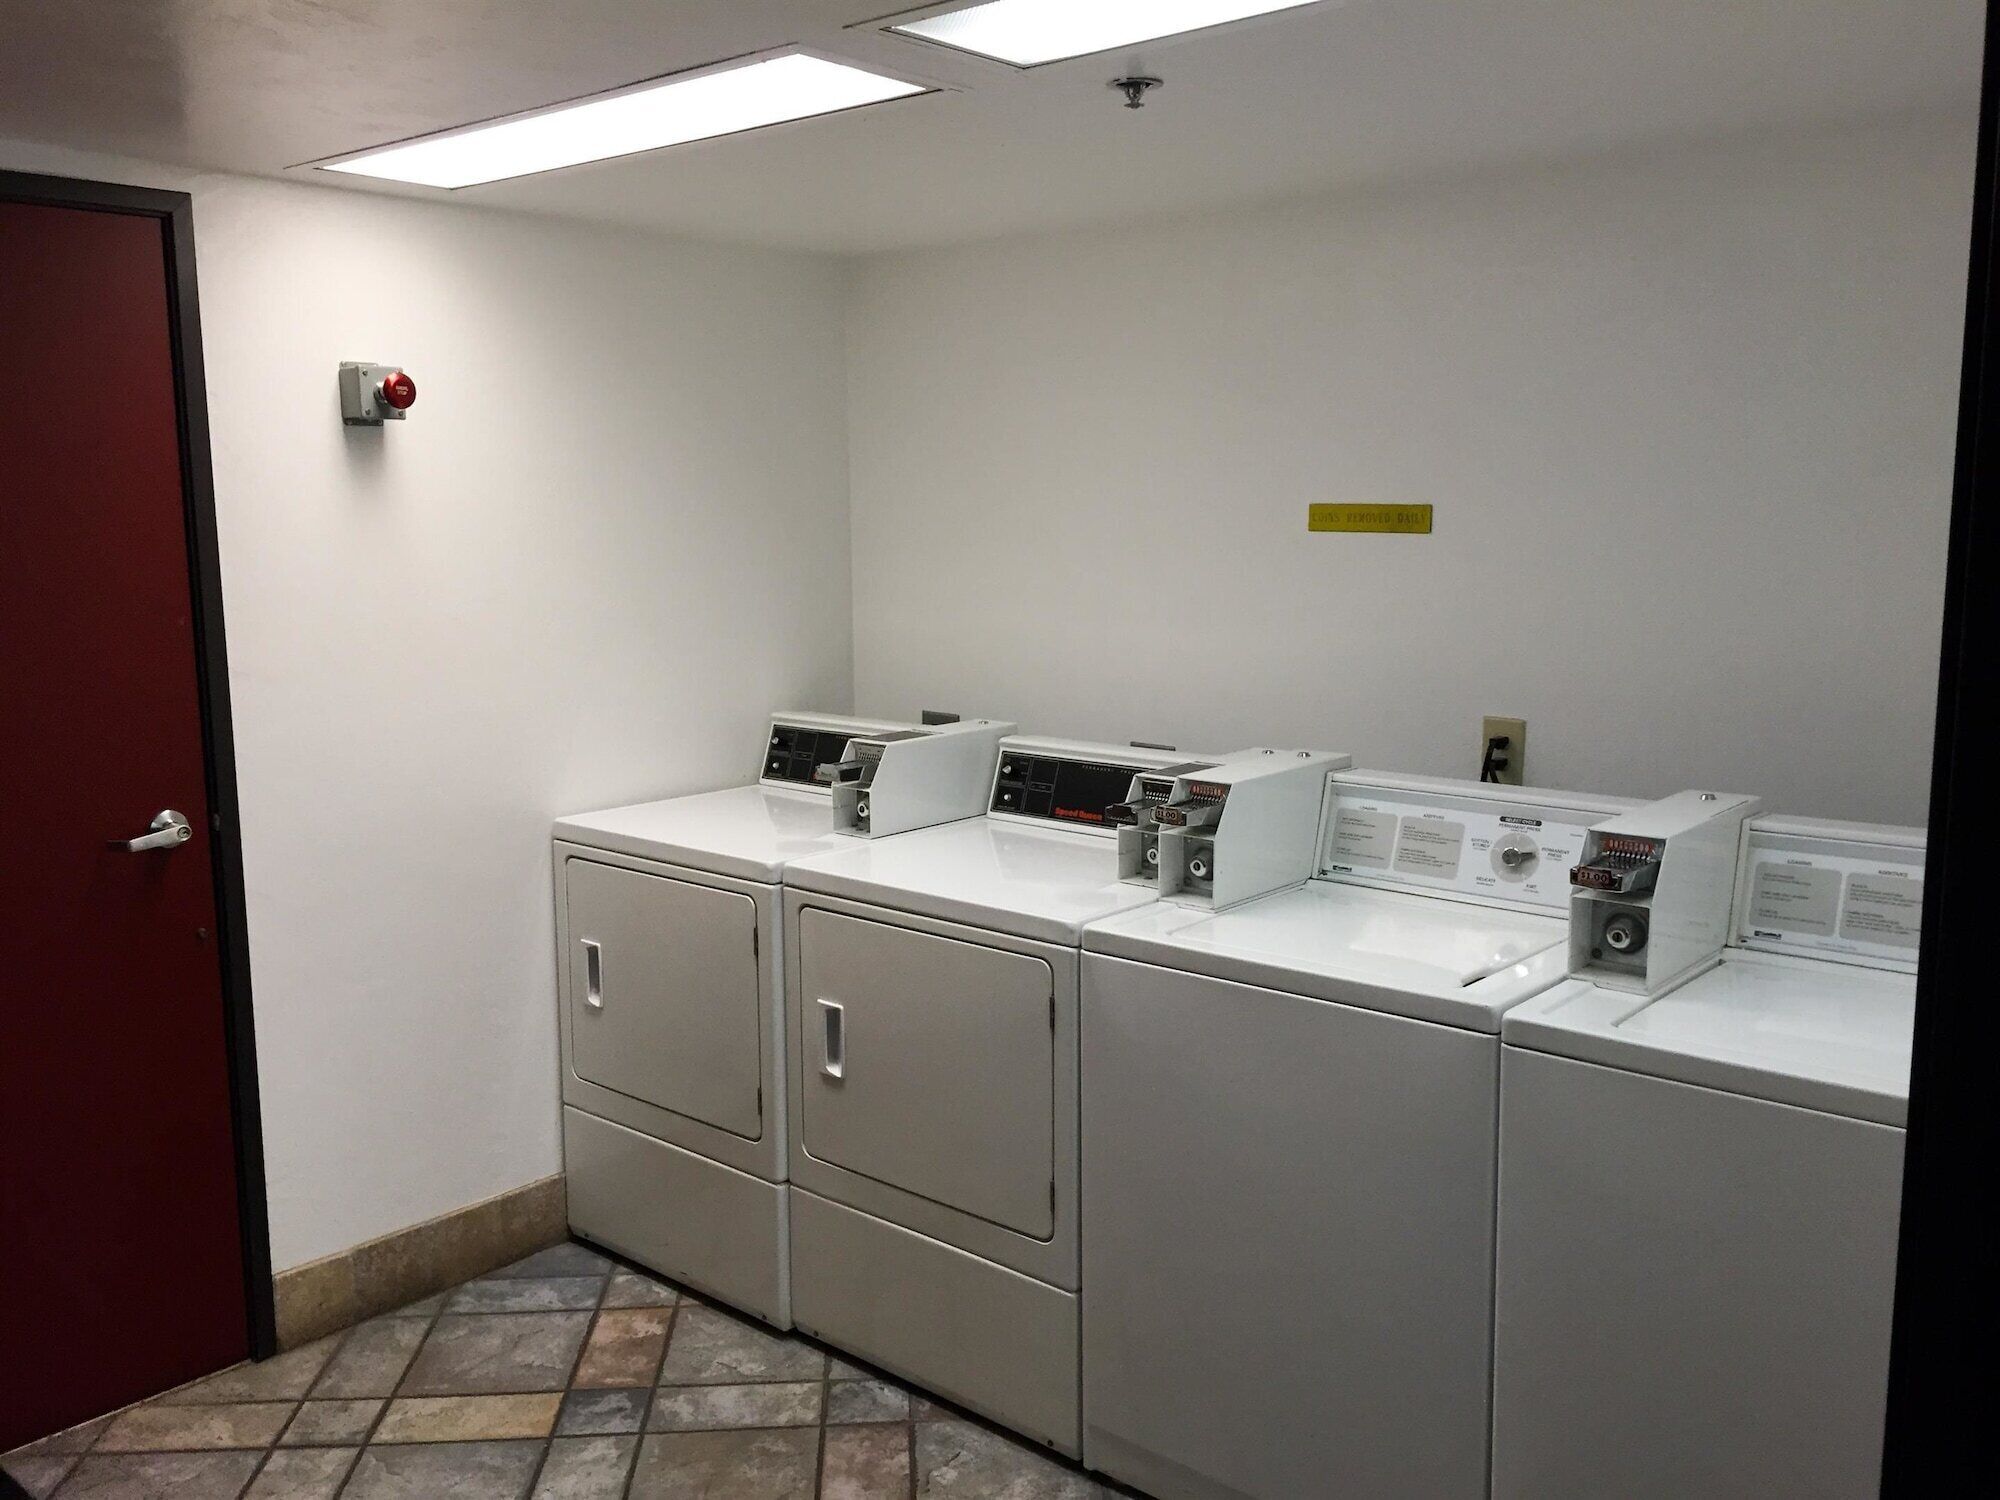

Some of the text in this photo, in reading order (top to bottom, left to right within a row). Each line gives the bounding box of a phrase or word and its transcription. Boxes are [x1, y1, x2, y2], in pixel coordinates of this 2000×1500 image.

[1346, 512, 1391, 524] REMOVED
[1396, 512, 1427, 525] DAILY
[1055, 806, 1103, 822] Speed Queen
[1156, 810, 1176, 820] $1.00
[1580, 871, 1608, 882] $1.00
